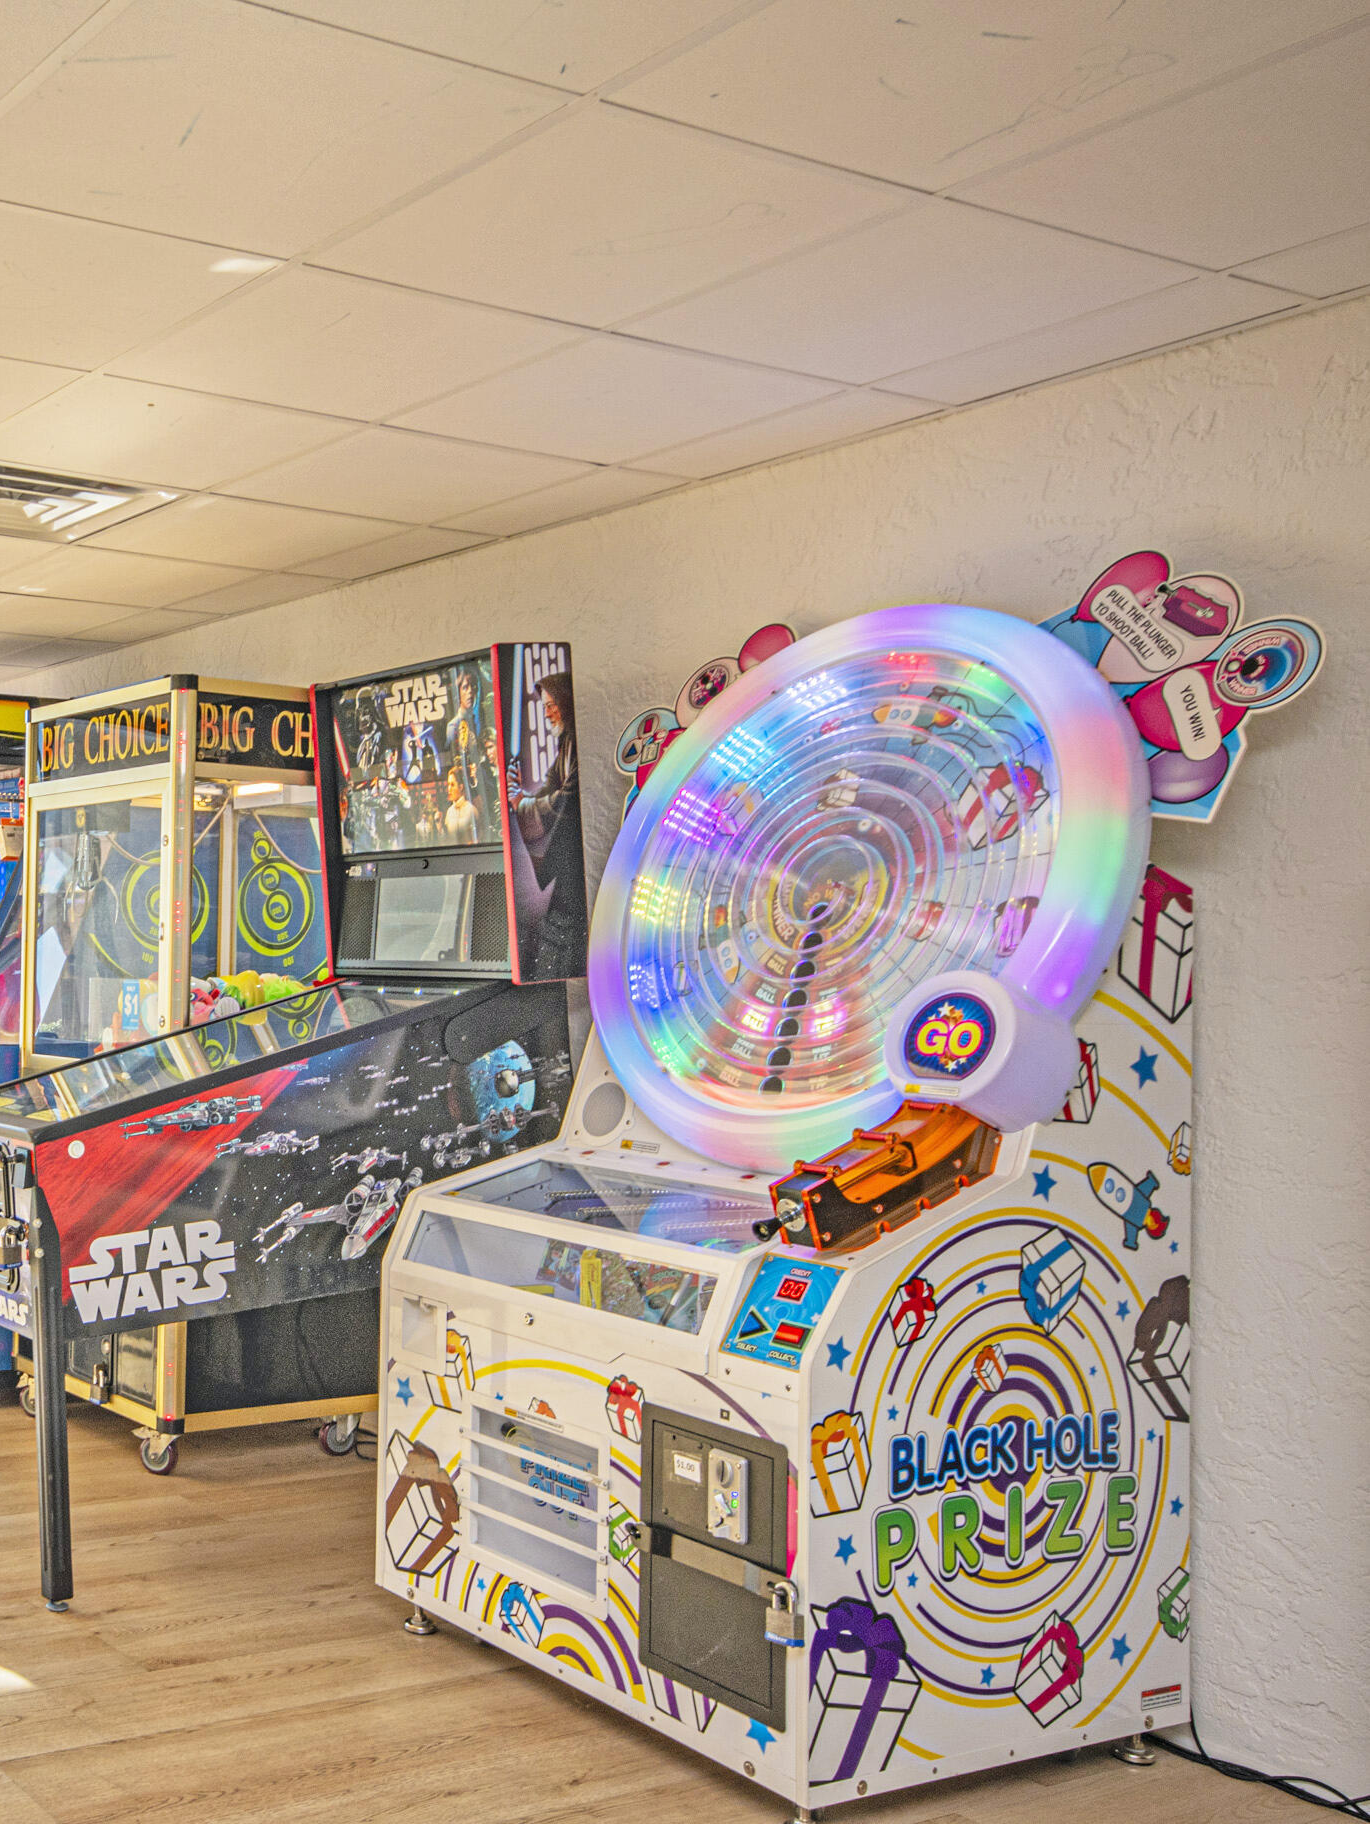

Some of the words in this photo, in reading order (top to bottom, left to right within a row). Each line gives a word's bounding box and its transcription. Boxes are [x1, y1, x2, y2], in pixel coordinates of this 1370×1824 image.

[1095, 602, 1109, 615] TO
[1105, 610, 1133, 641] SHOOT
[1130, 635, 1154, 661] BALL!
[1107, 588, 1127, 611] PULL
[1125, 604, 1145, 627] THE
[1140, 621, 1178, 660] PLUNGER
[385, 674, 447, 705] STAR
[198, 702, 255, 753] BIG
[386, 695, 448, 728] WARS
[1180, 685, 1196, 712] YOU
[1189, 713, 1206, 742] WIN!
[41, 722, 75, 772] BIG
[84, 702, 170, 764] CHOICE
[124, 993, 139, 1017] $1
[755, 988, 776, 1004] BALL
[731, 1044, 753, 1060] BALL
[915, 1018, 984, 1058] GO
[68, 1220, 235, 1283] STAR
[69, 1257, 237, 1324] WARS
[791, 1268, 813, 1277] CREDIT
[736, 1342, 758, 1352] SELECT
[769, 1351, 795, 1361] COLLECT
[676, 1460, 695, 1473] $1.00
[890, 1420, 1017, 1499] BLACK
[1024, 1409, 1120, 1471] HOLE
[872, 1472, 1138, 1594] PRIZE
